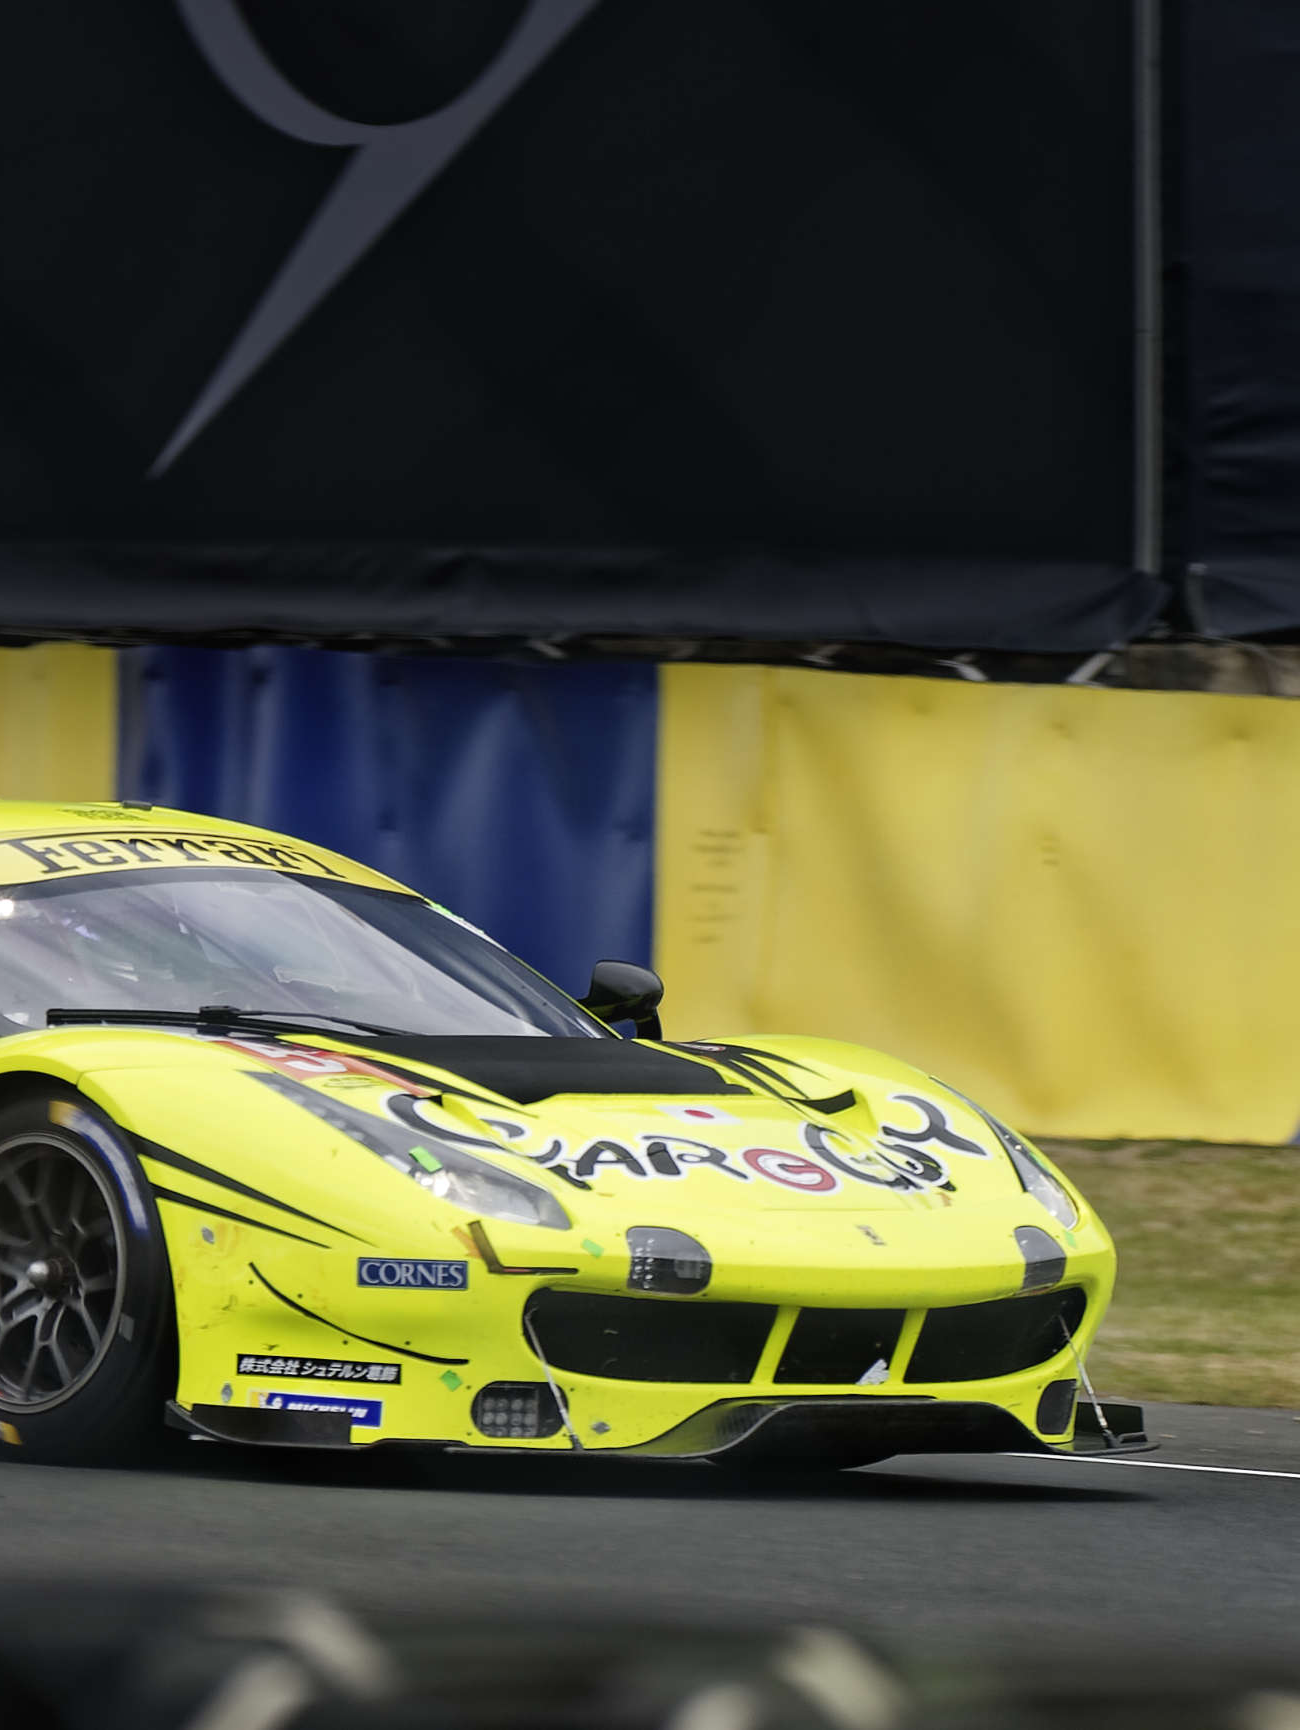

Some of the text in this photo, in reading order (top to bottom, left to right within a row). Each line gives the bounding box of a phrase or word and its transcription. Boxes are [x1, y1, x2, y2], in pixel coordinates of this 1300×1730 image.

[361, 1261, 464, 1287] CORNES
[239, 1356, 299, 1376] 株式会社
